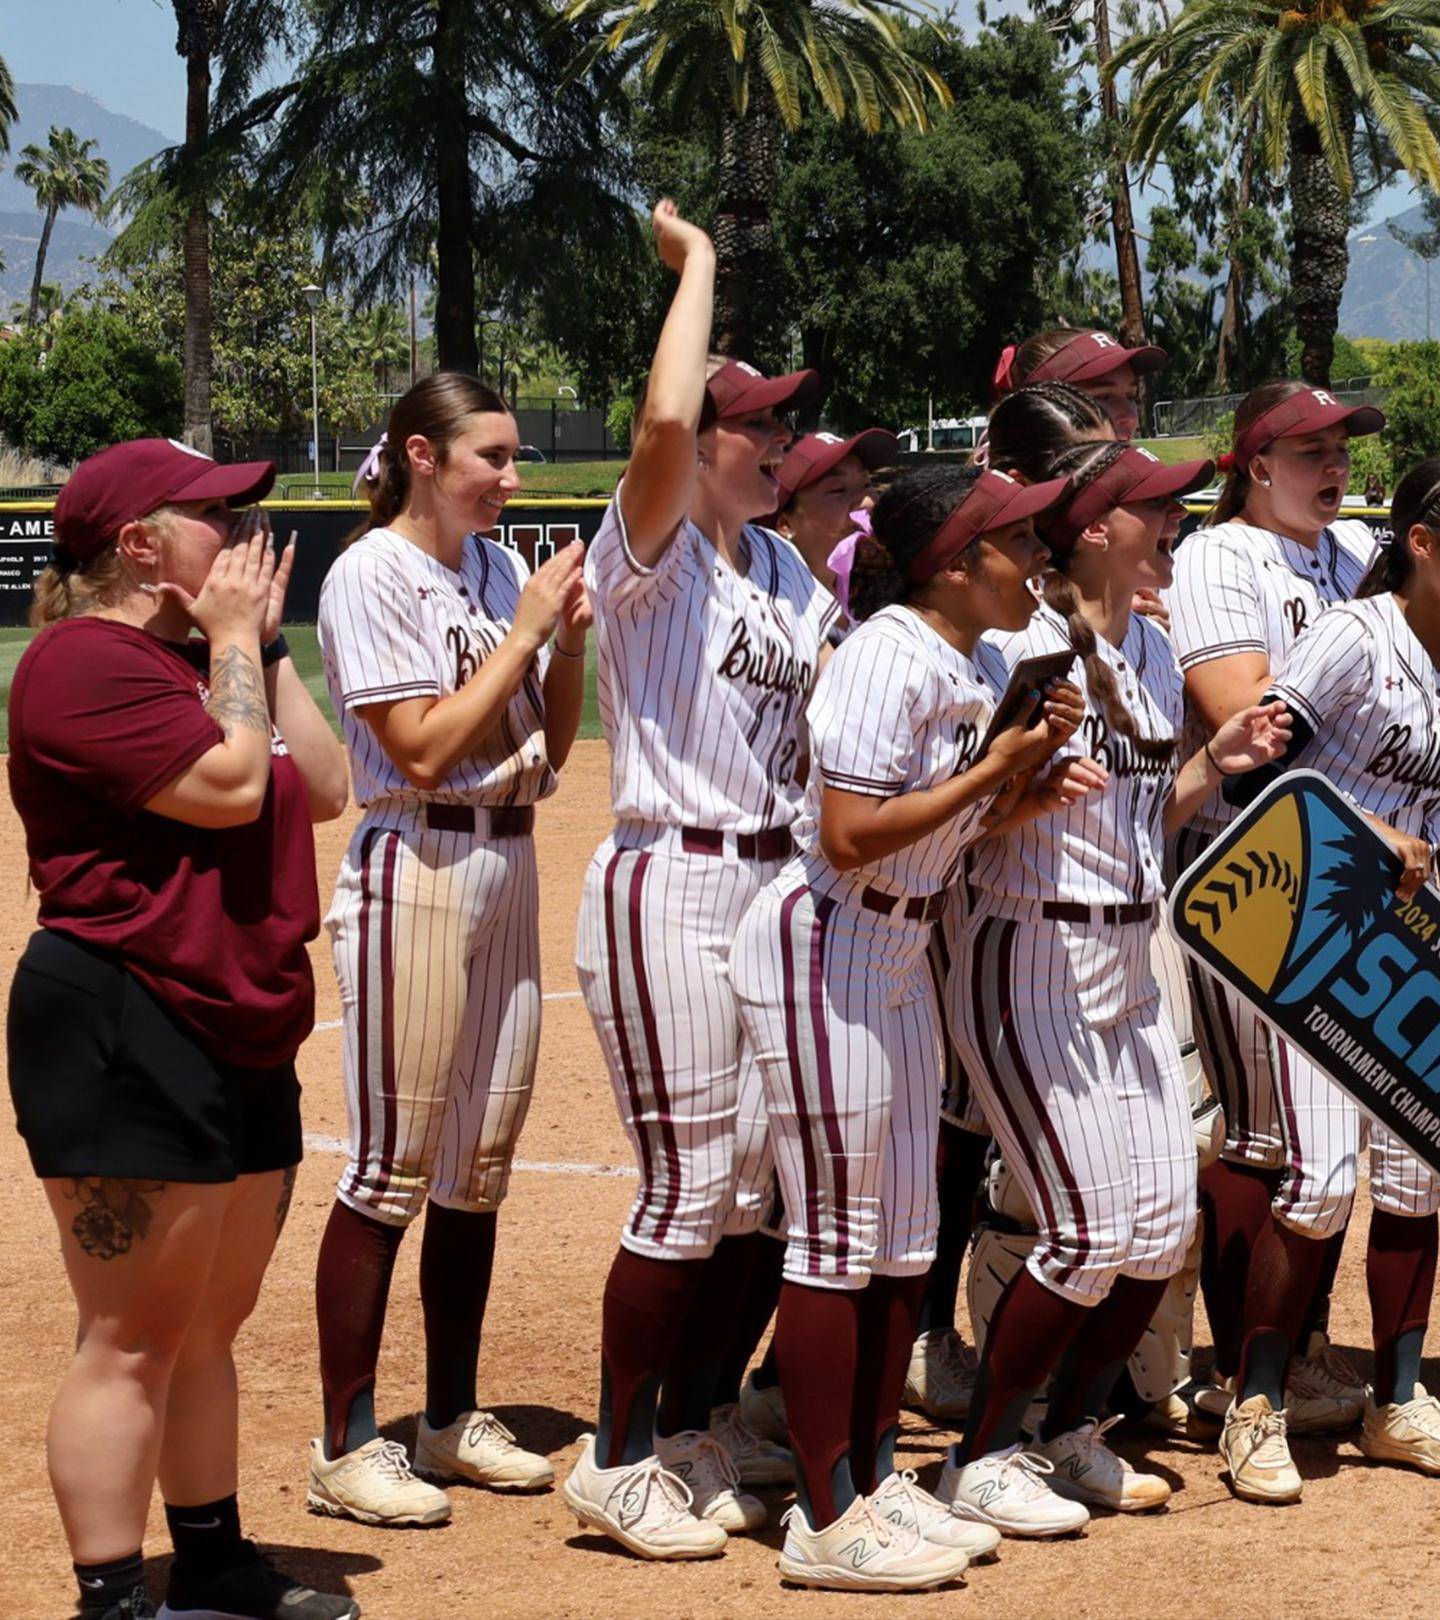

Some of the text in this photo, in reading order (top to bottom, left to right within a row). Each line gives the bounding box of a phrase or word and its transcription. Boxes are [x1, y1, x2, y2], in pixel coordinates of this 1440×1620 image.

[1312, 389, 1337, 405] R
[1394, 892, 1438, 942] 2024
[1303, 1003, 1398, 1096] TOURNAMENT
